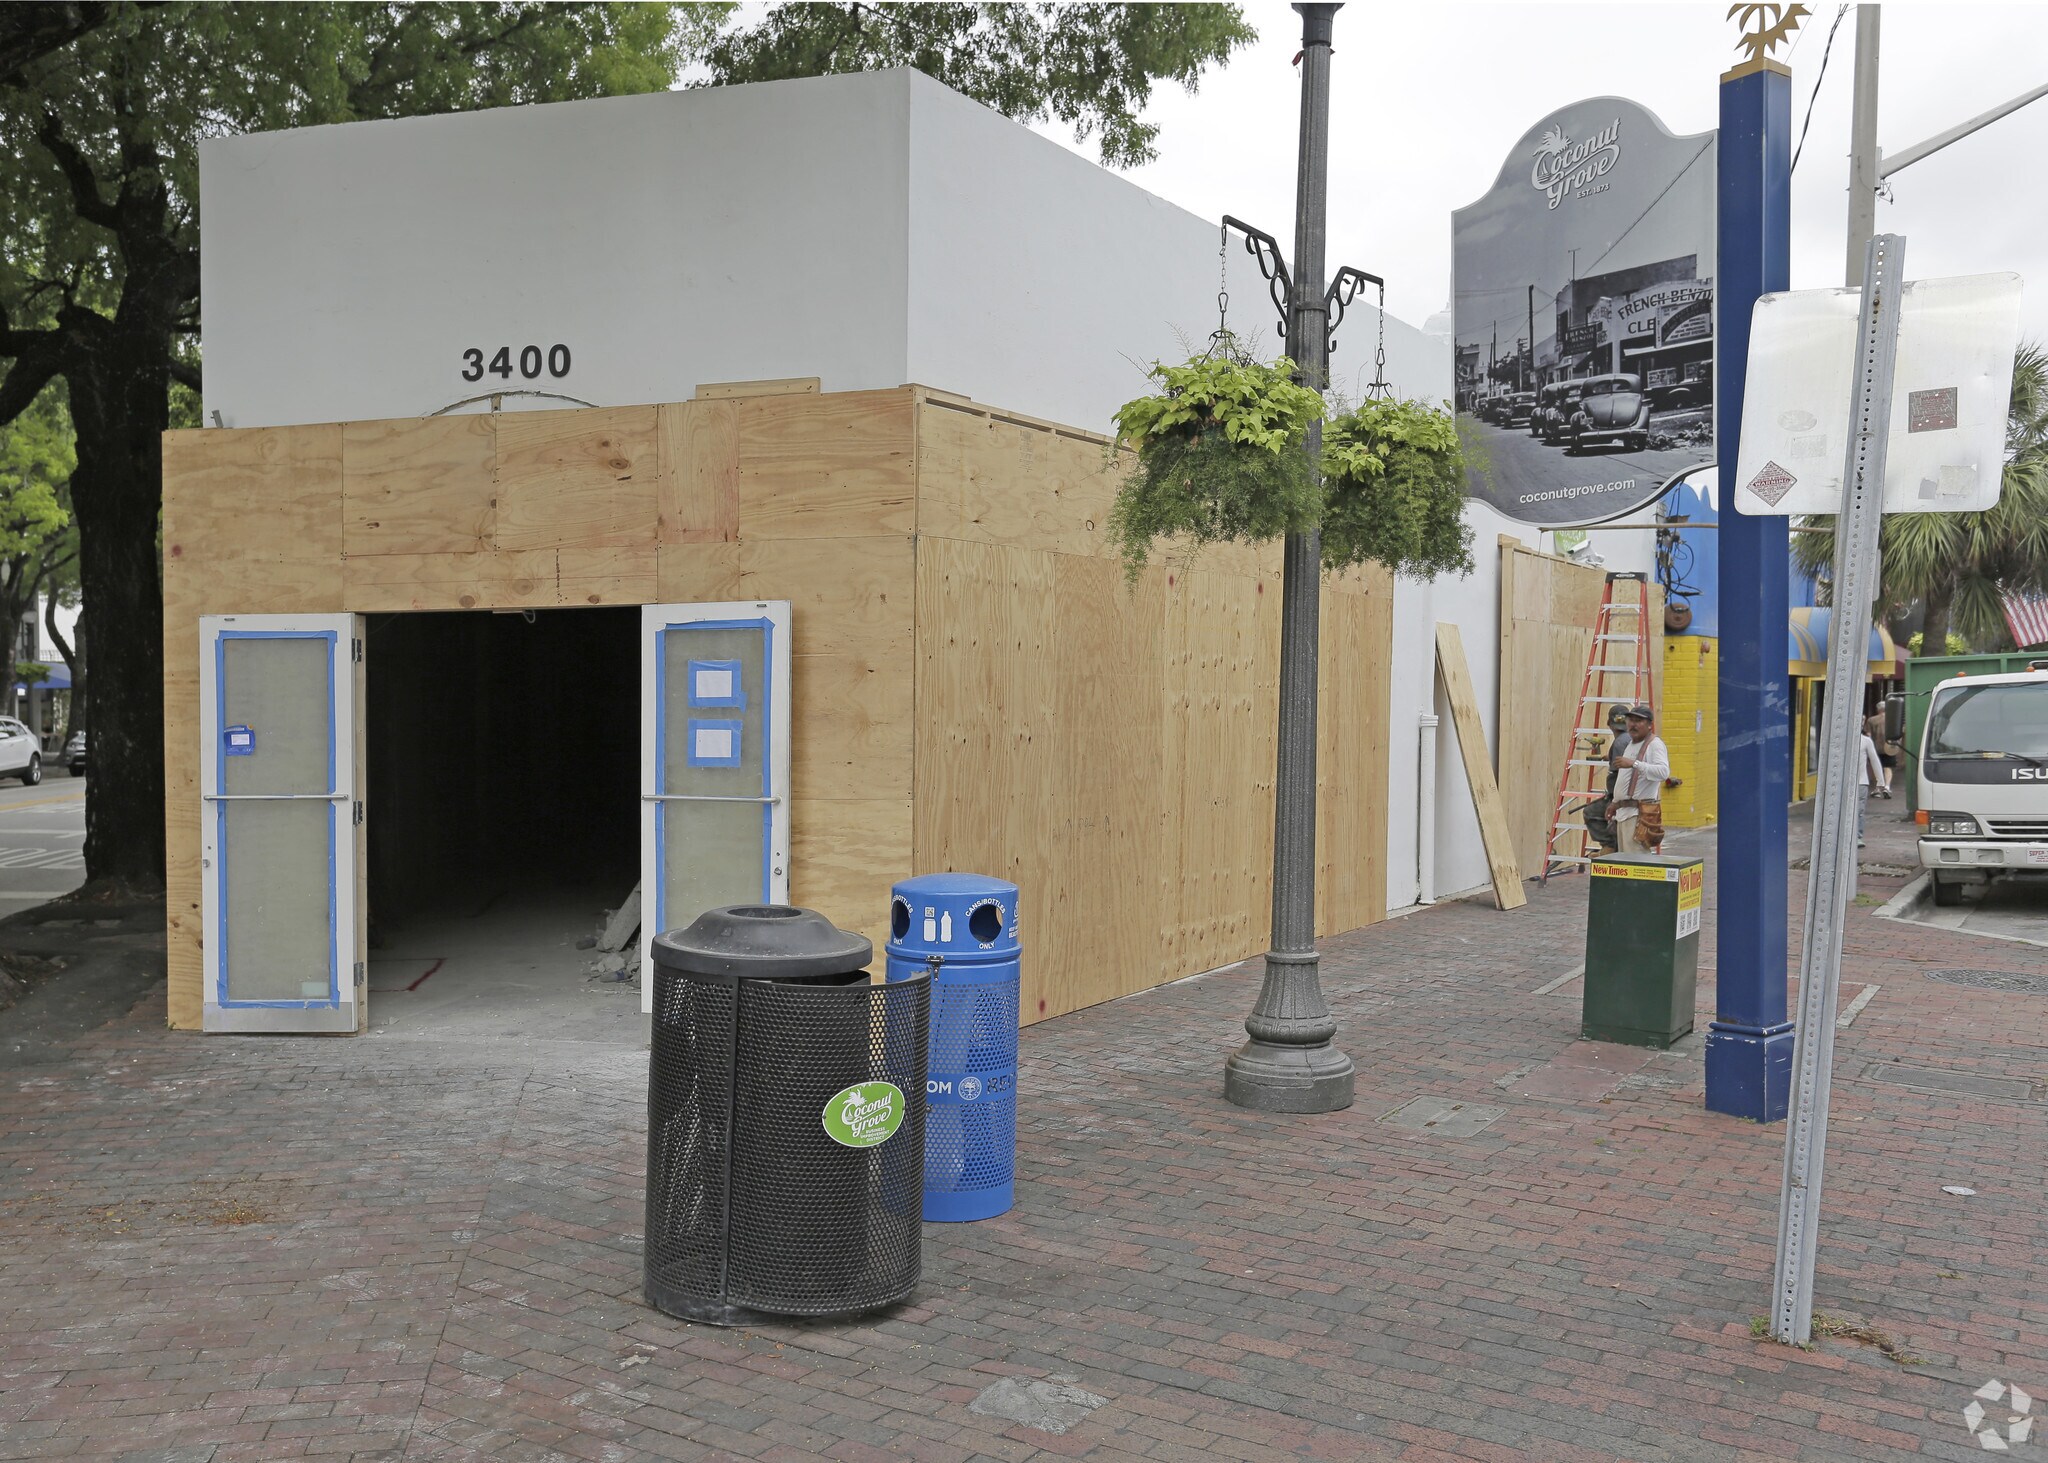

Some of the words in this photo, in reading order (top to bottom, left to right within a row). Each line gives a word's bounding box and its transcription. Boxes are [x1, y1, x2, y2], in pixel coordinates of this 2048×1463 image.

[1532, 117, 1621, 190] Coconut
[1576, 188, 1592, 199] EST.
[1593, 183, 1611, 194] 1873
[461, 343, 572, 382] 3400
[1519, 479, 1636, 504] coconutgrove.com
[2011, 768, 2048, 780] ISU
[1592, 864, 1608, 875] New
[1608, 865, 1629, 877] Times
[979, 941, 995, 950] ONLY
[842, 1091, 893, 1126] Coconut
